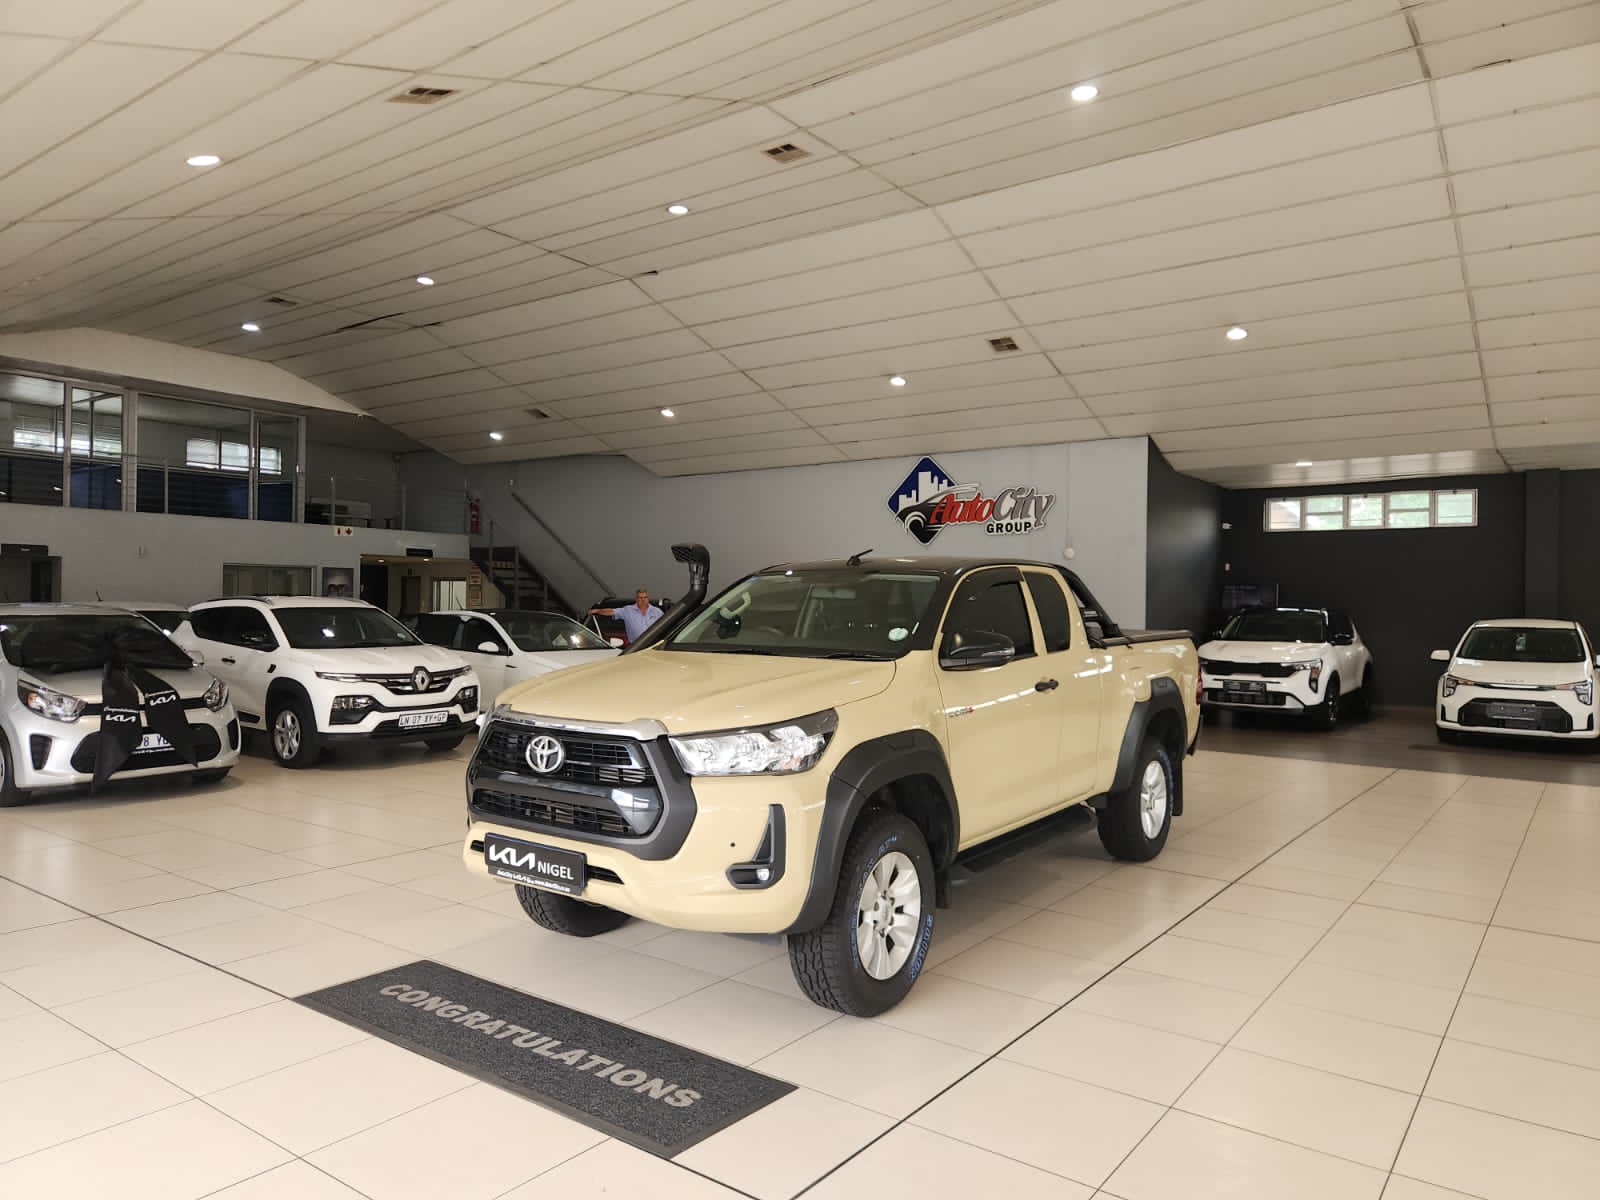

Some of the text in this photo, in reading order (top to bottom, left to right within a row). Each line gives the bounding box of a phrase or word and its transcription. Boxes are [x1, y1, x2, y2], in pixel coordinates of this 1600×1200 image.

[929, 487, 1055, 527] AutoCity
[986, 521, 1032, 534] GROUP
[149, 694, 176, 706] KIA
[105, 714, 136, 722] KIA
[489, 844, 575, 880] KIA NIGEL
[380, 984, 701, 1108] CONGRATULATIONS
